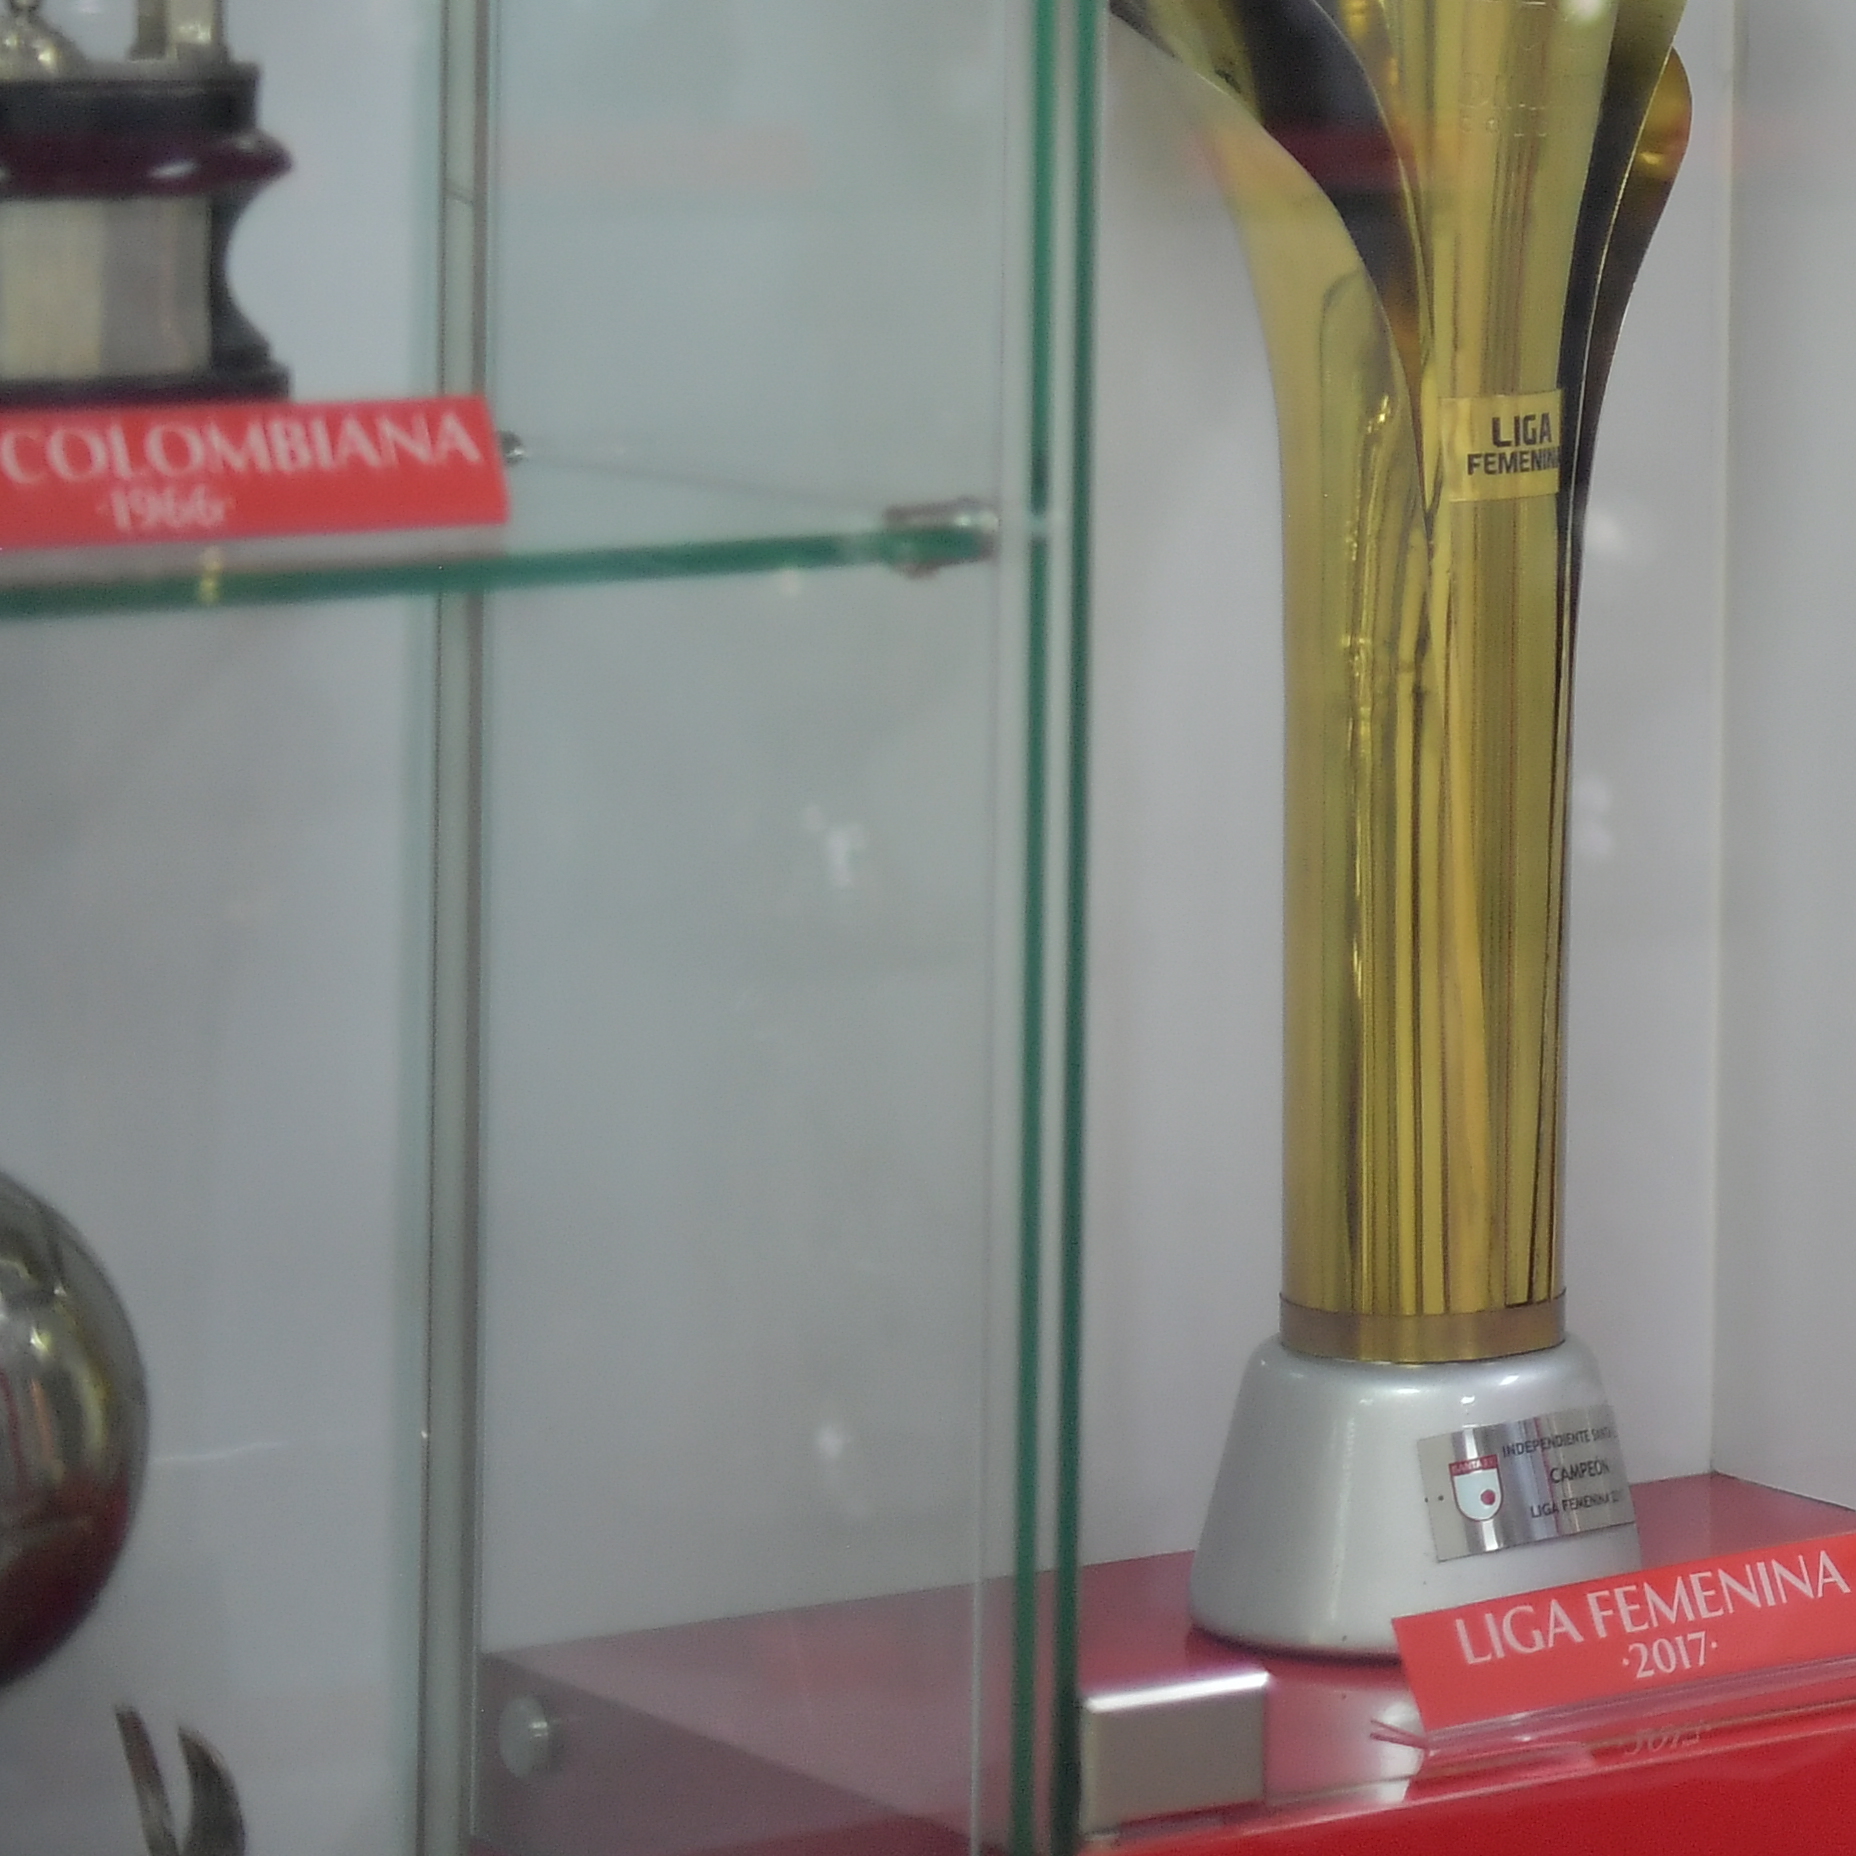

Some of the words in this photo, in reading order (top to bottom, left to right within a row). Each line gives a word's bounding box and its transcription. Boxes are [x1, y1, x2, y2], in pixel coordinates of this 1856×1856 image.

[1491, 412, 1553, 448] LIGA
[1, 413, 484, 485] COLOMBIANA
[1502, 1428, 1591, 1458] INDEPENDIENTE
[1530, 1501, 1560, 1518] LIGA
[1455, 1597, 1584, 1666] LIGA
[1585, 1549, 1852, 1640] FEMENINA
